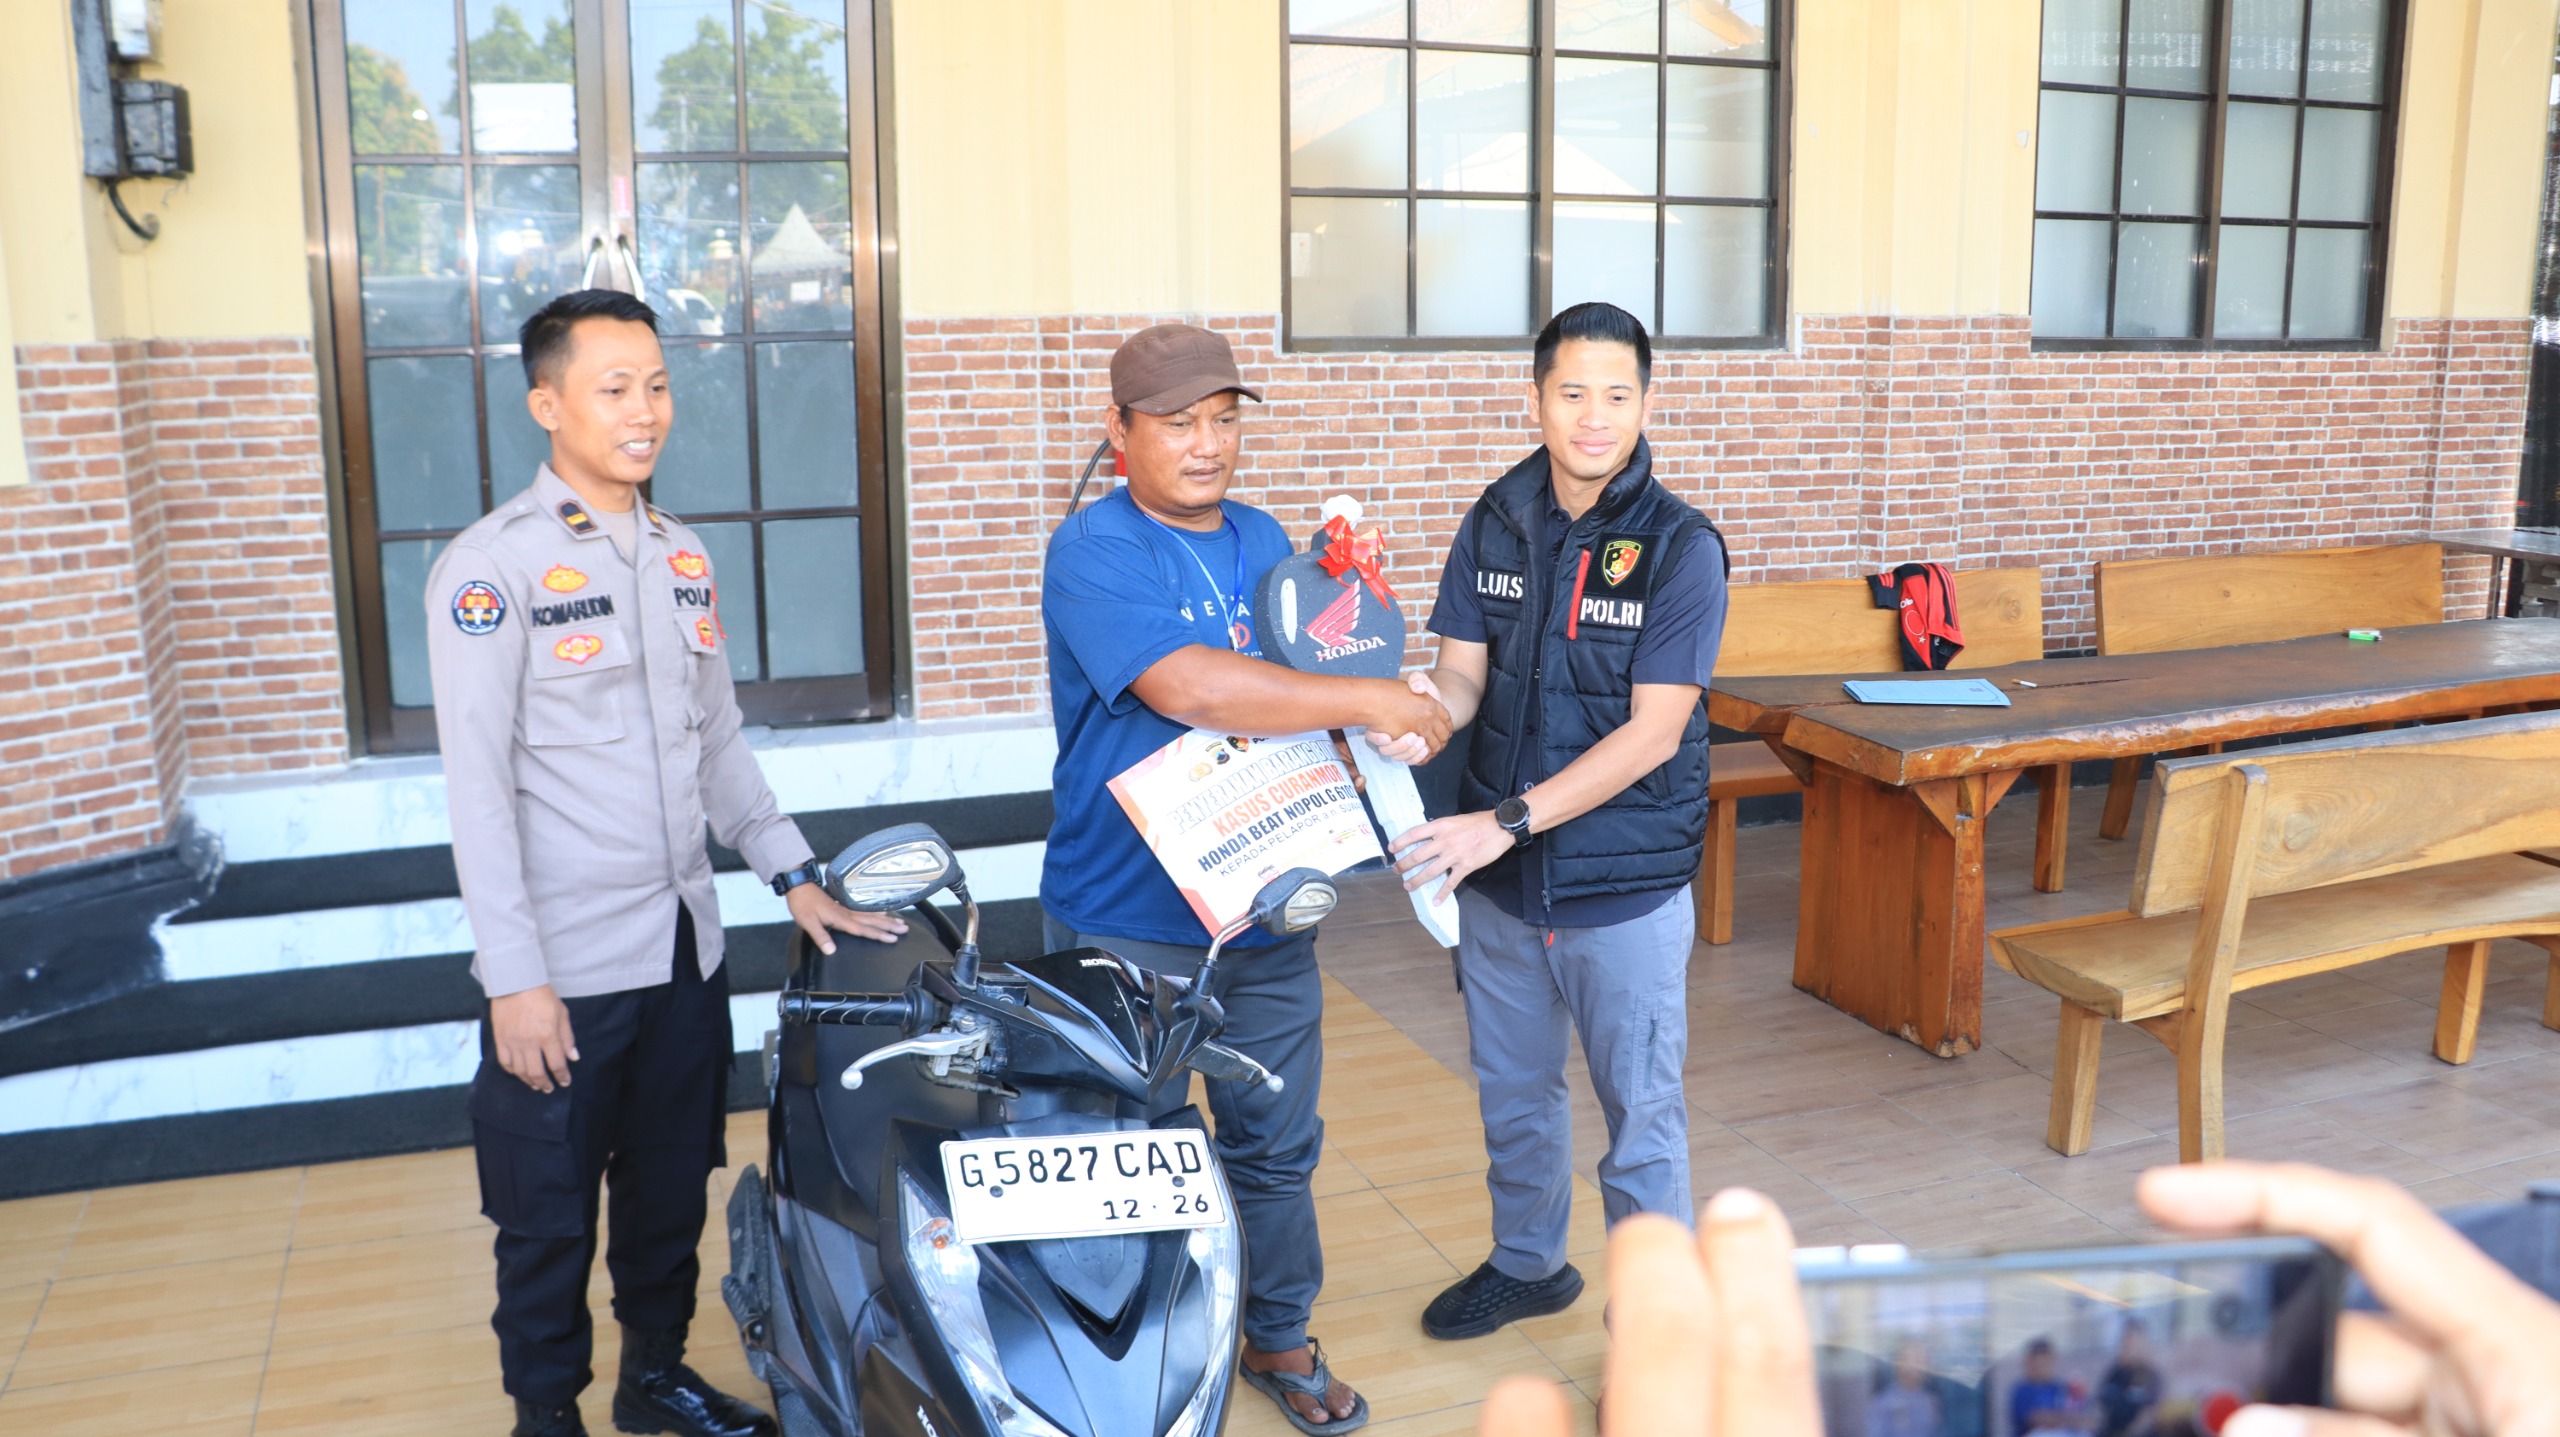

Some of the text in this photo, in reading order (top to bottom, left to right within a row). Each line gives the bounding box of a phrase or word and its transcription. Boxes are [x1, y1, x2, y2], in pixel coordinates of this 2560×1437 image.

[1477, 571, 1523, 599] LUIS
[531, 594, 615, 627] KOMARUDIN
[1580, 598, 1643, 626] POLRI
[1315, 636, 1387, 662] HONDA
[1166, 762, 1269, 835] PENYERAHAN
[1259, 742, 1320, 780] BARANG
[1212, 764, 1345, 837] KASUS CURANMOR
[1197, 832, 1251, 872] HONDA
[1248, 811, 1285, 841] BEAT
[1283, 792, 1329, 820] NOPOL
[1325, 788, 1338, 802] G
[1219, 845, 1268, 877] KEPADA
[1268, 814, 1321, 847] PELAPOR
[1079, 958, 1122, 969] HONDA
[960, 1141, 1201, 1187] G 5827 CAD
